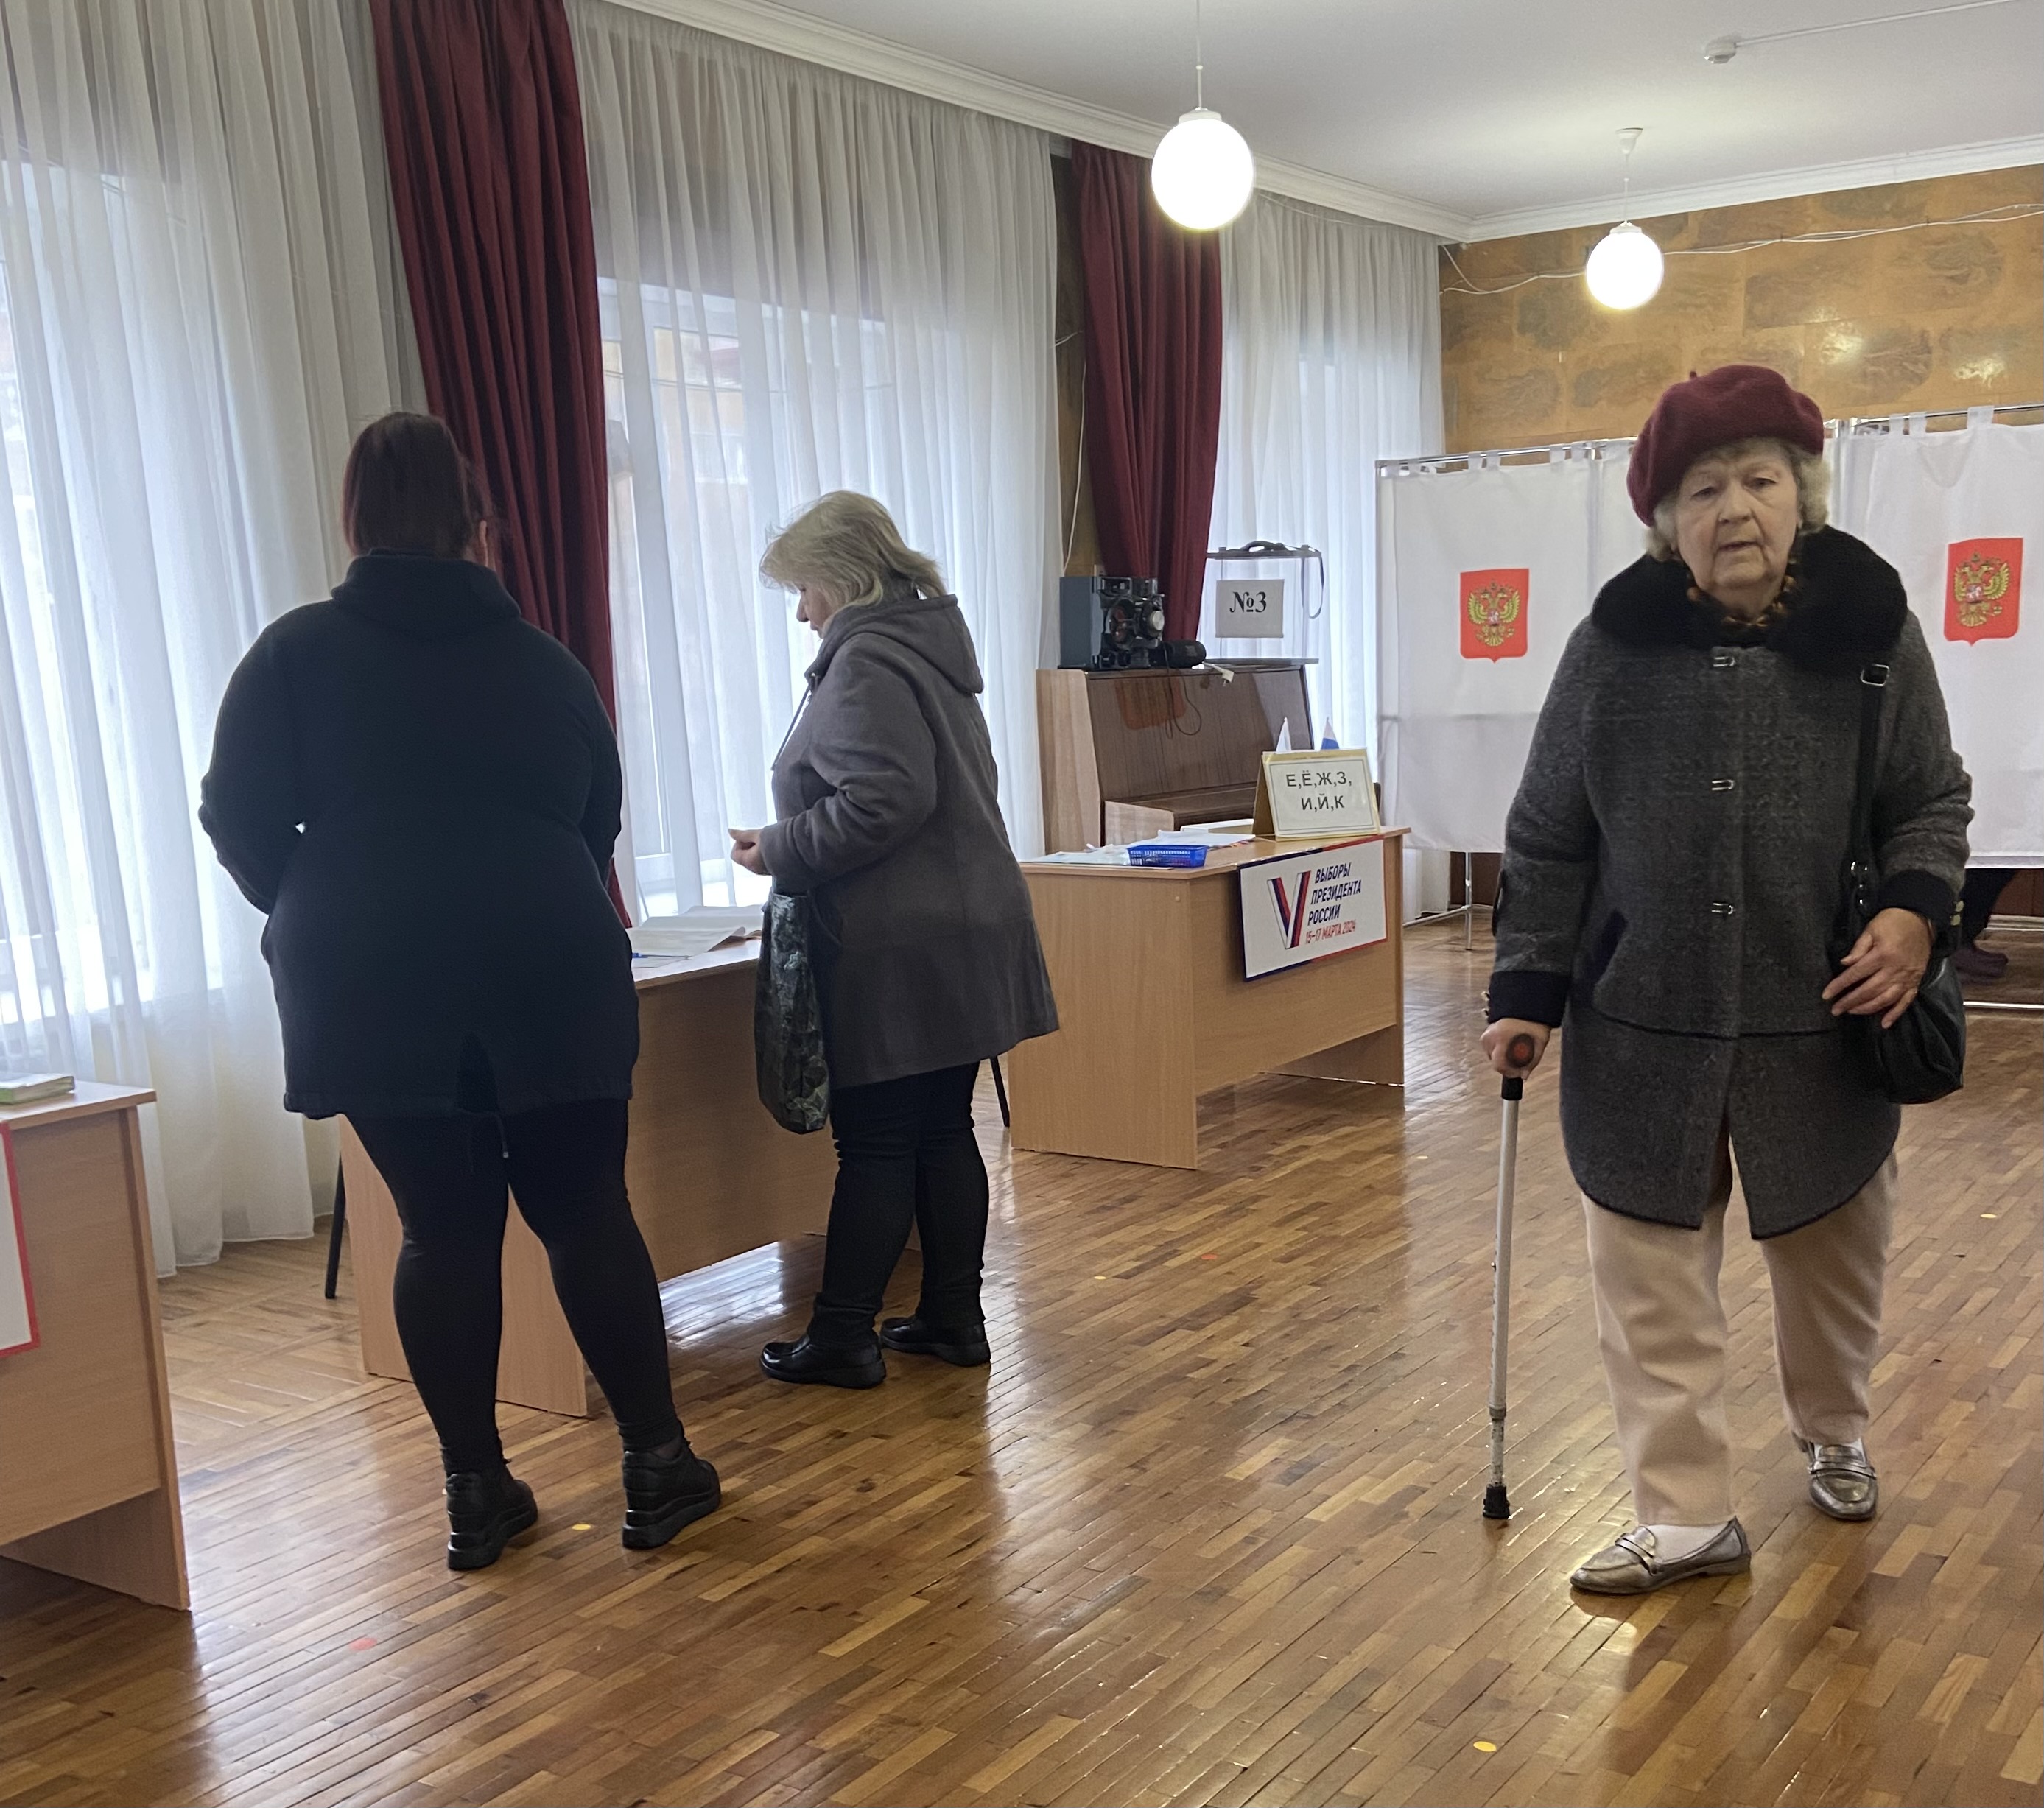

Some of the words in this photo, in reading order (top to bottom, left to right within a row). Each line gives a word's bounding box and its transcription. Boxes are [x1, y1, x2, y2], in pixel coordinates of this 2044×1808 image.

[1229, 591, 1267, 613] №3
[1301, 792, 1345, 812] И,Й,К
[1315, 862, 1352, 884] ВЫБОРЫ
[1310, 879, 1361, 905] ПРЕЗИДЕНТА
[1307, 904, 1341, 926] РОССИИ
[1322, 922, 1342, 940] МАРТА
[1342, 918, 1356, 935] 2024
